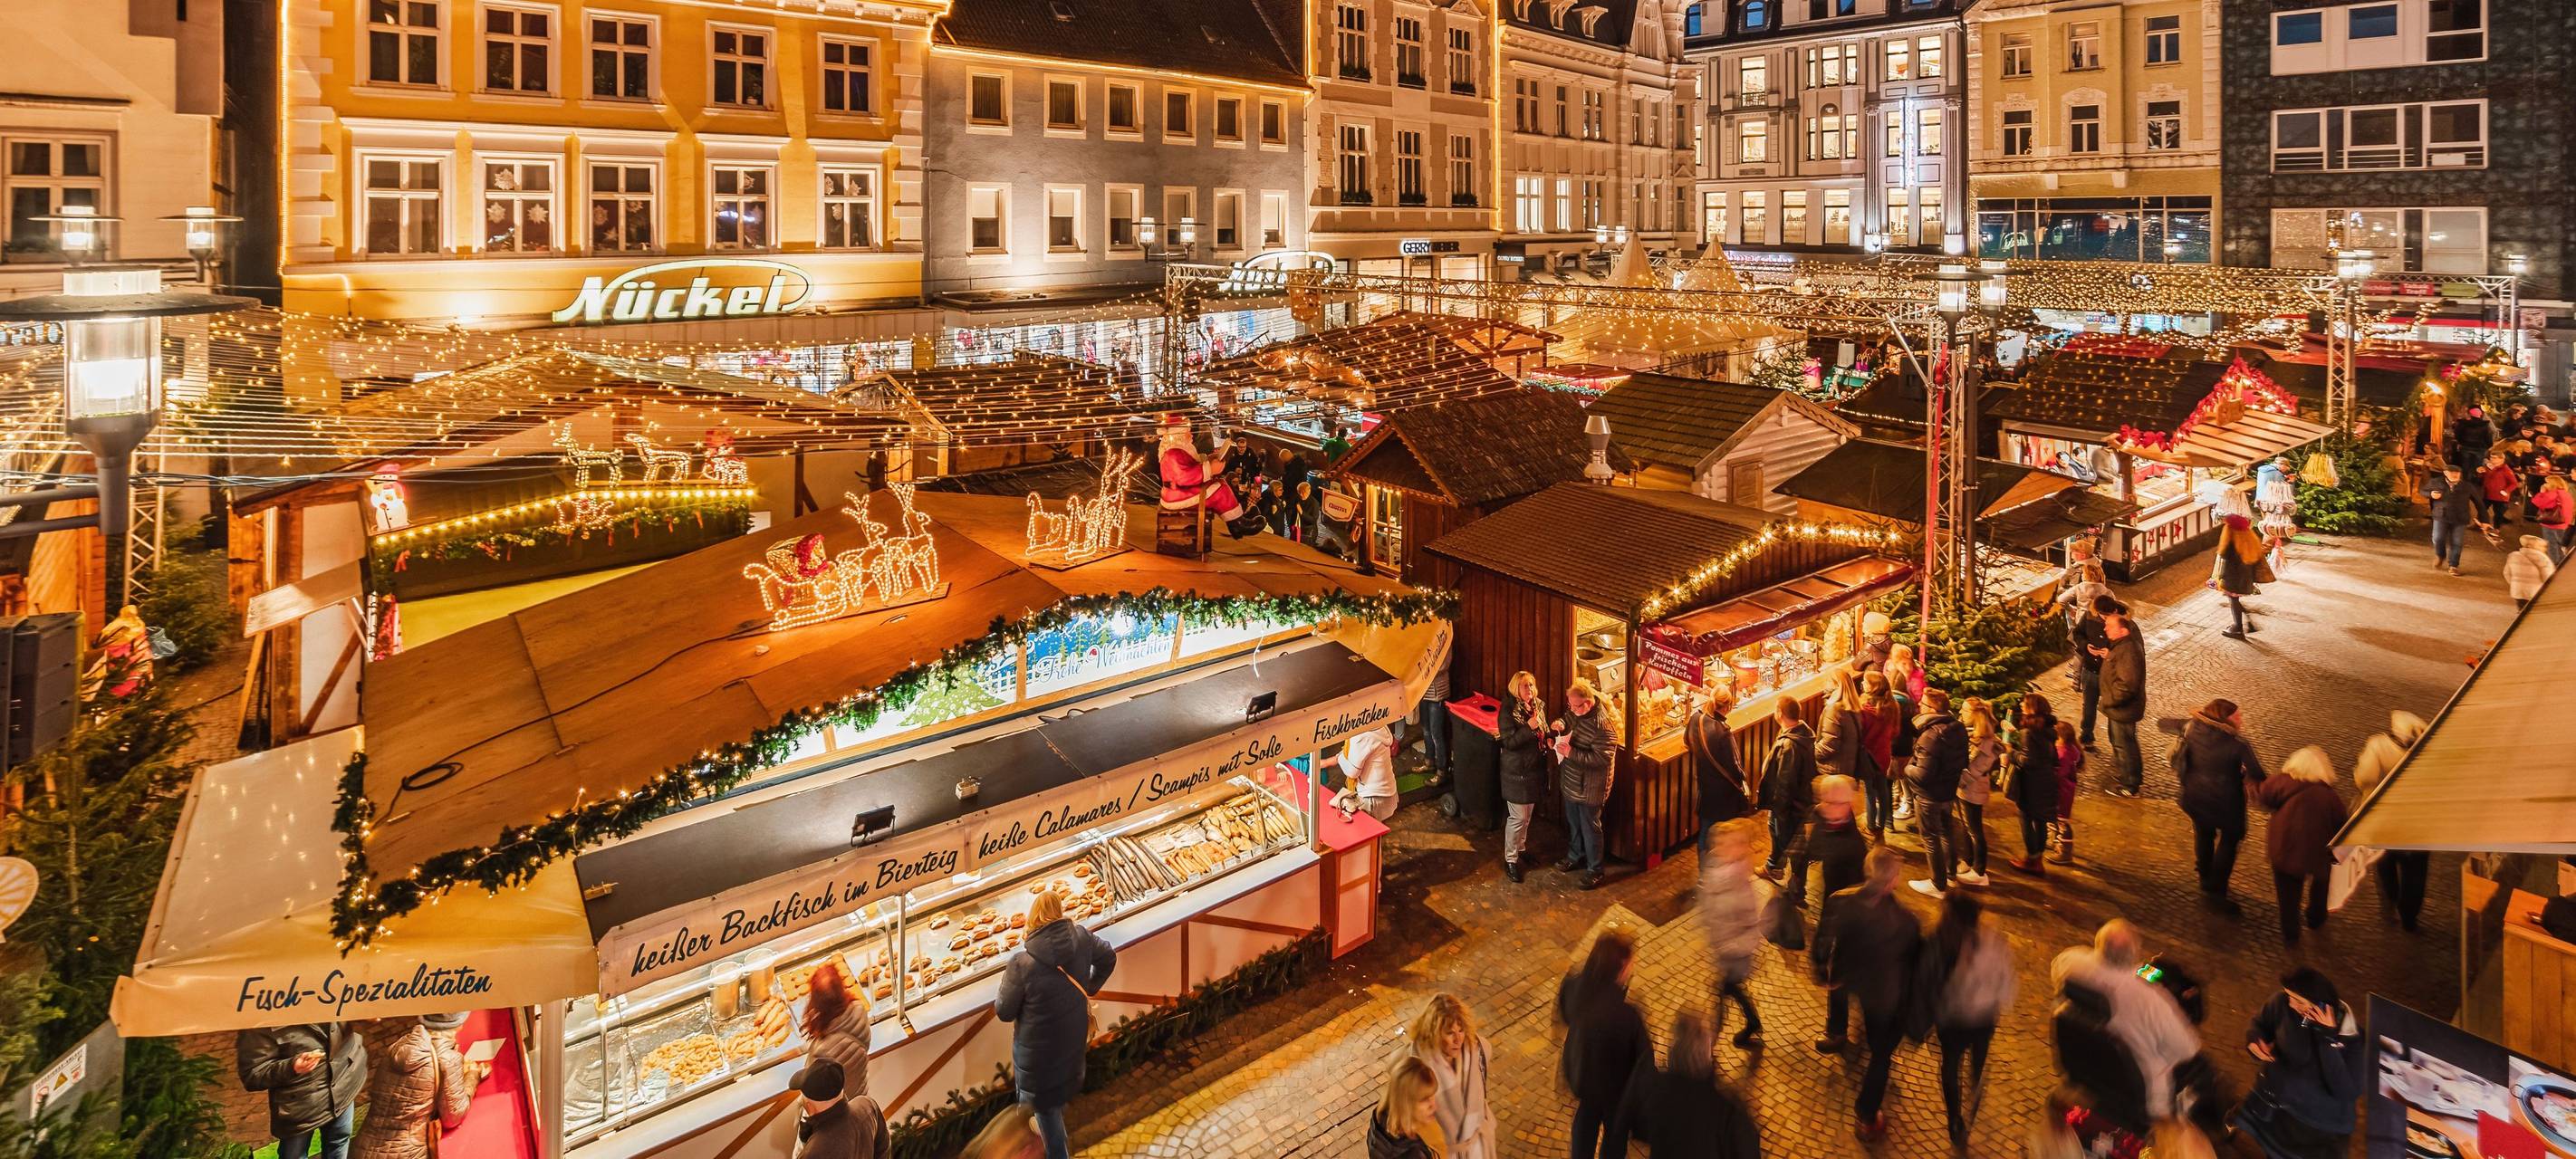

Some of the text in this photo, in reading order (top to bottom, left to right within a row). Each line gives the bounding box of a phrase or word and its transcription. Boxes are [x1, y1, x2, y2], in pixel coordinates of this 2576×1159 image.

[1403, 241, 1431, 254] GERRY
[552, 260, 813, 323] Nückel
[1036, 633, 1171, 684] Frohe Weihnachten
[1645, 641, 1680, 659] Pommes
[1653, 652, 1687, 670] frischen
[1648, 657, 1693, 680] Kartoffeln
[630, 926, 714, 978] heißer
[720, 881, 837, 945] Backfisch
[844, 880, 870, 903] im
[875, 849, 958, 890] Bierteig
[978, 820, 1029, 859] heiße
[1034, 797, 1121, 838] Calamares
[1146, 767, 1210, 802] Scampis
[1217, 750, 1245, 779] mit
[1244, 735, 1283, 766] Soße
[1313, 703, 1390, 744] Fischbrötchen
